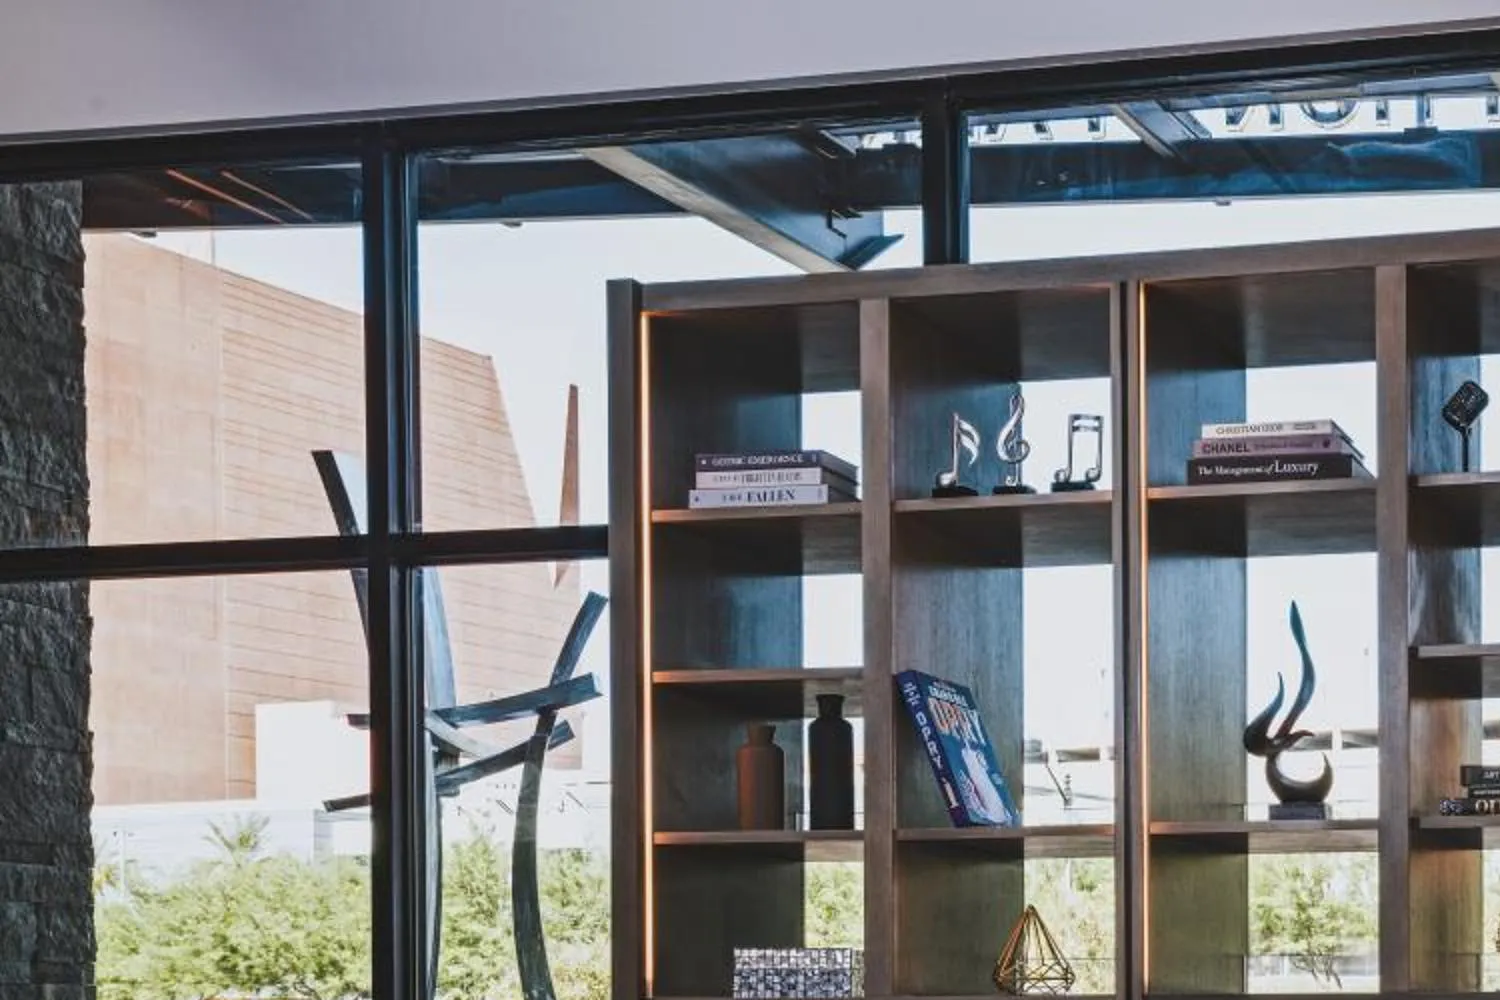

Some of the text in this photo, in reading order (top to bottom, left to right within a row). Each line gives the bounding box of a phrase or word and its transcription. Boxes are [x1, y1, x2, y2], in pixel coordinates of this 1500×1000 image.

[1202, 441, 1250, 454] CHANEL
[1274, 460, 1319, 476] Luxury
[747, 488, 796, 503] FALLEN
